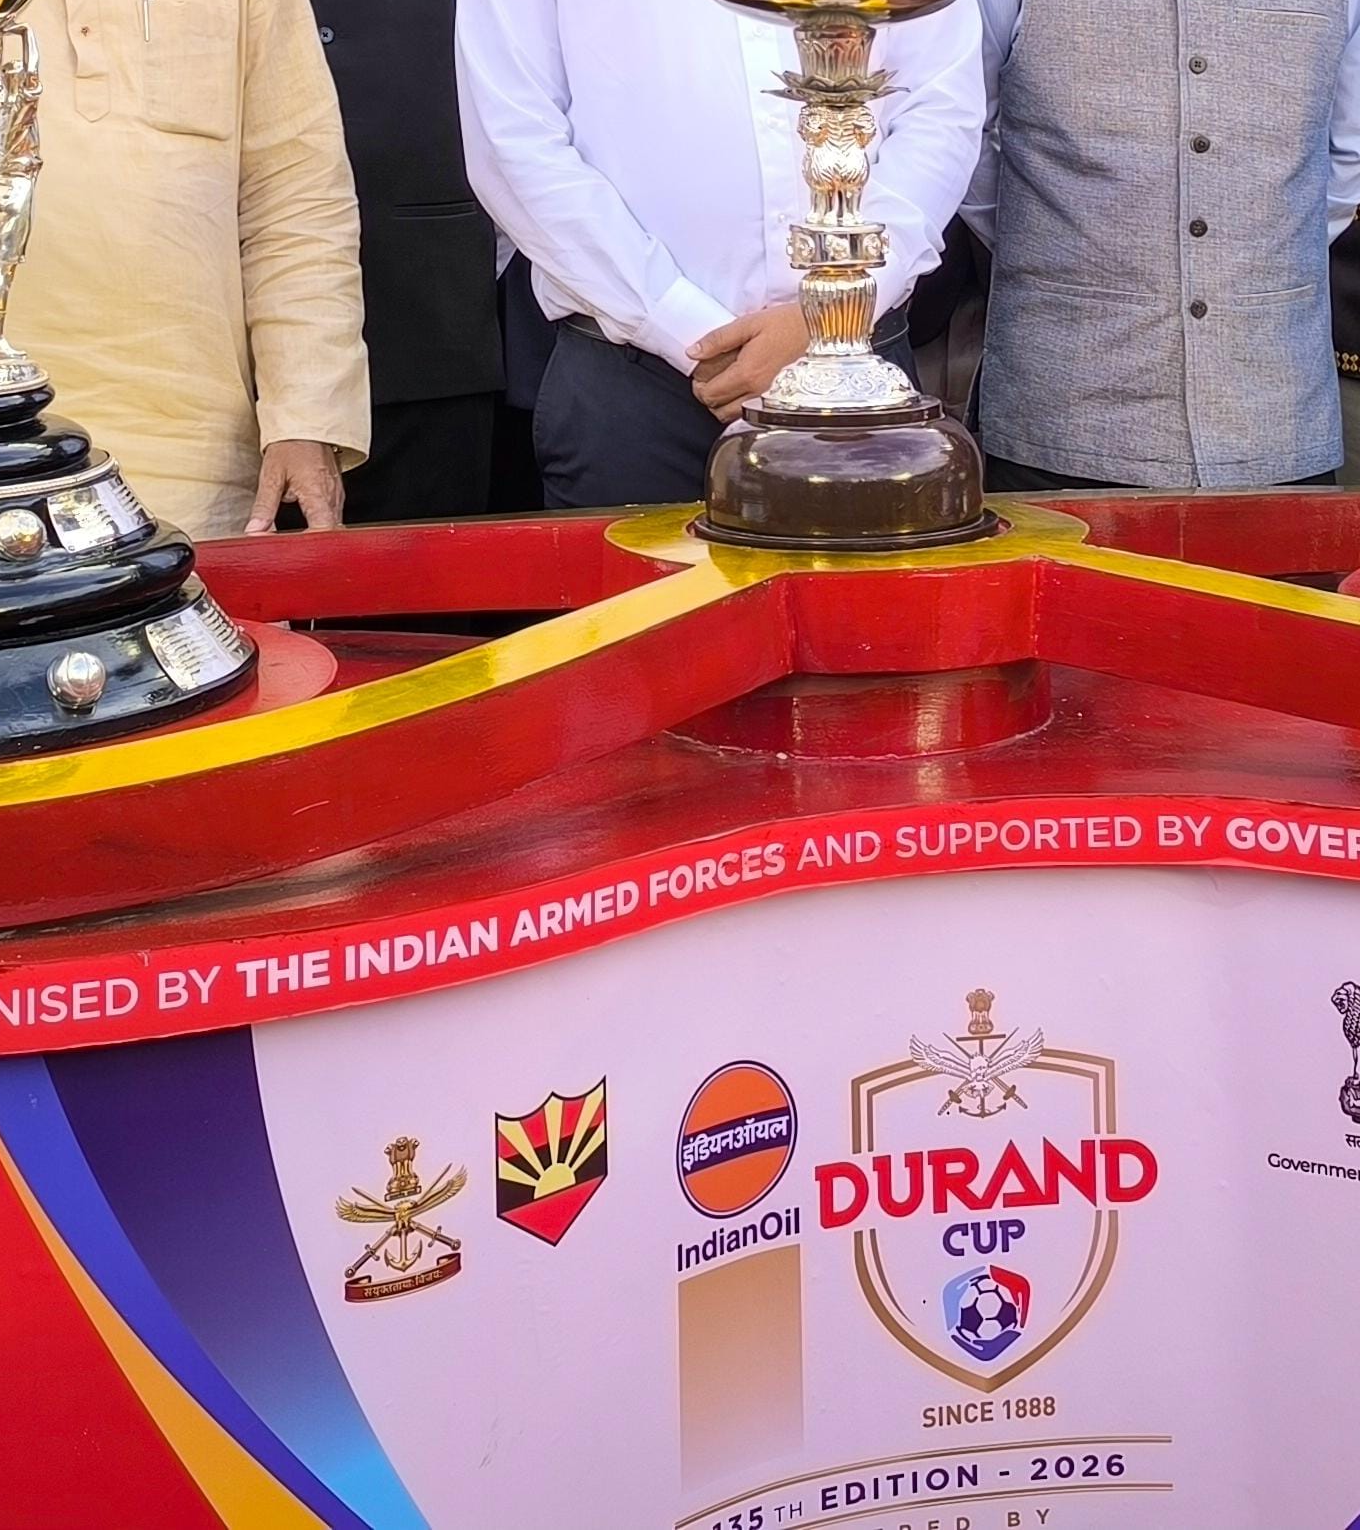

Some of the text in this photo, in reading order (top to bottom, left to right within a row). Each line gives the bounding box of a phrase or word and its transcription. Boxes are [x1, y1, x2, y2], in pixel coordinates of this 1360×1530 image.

[157, 965, 222, 1010] BY
[235, 950, 331, 998] THE
[345, 916, 499, 982] INDIAN
[508, 880, 640, 948] ARMED
[649, 842, 785, 907] FORCES
[796, 830, 881, 870] AND
[895, 816, 1142, 859] SUPPORTED
[1157, 815, 1212, 848] BY
[682, 1115, 790, 1171] इंडियनऑयल
[814, 1136, 1158, 1229] DURAND
[677, 1207, 800, 1272] IndianOil
[942, 1219, 1026, 1257] CUP
[922, 1396, 1056, 1428] SINCE 1888
[820, 1464, 979, 1511] EDITION
[1030, 1454, 1126, 1481] 2026
[1007, 1508, 1050, 1527] BY
